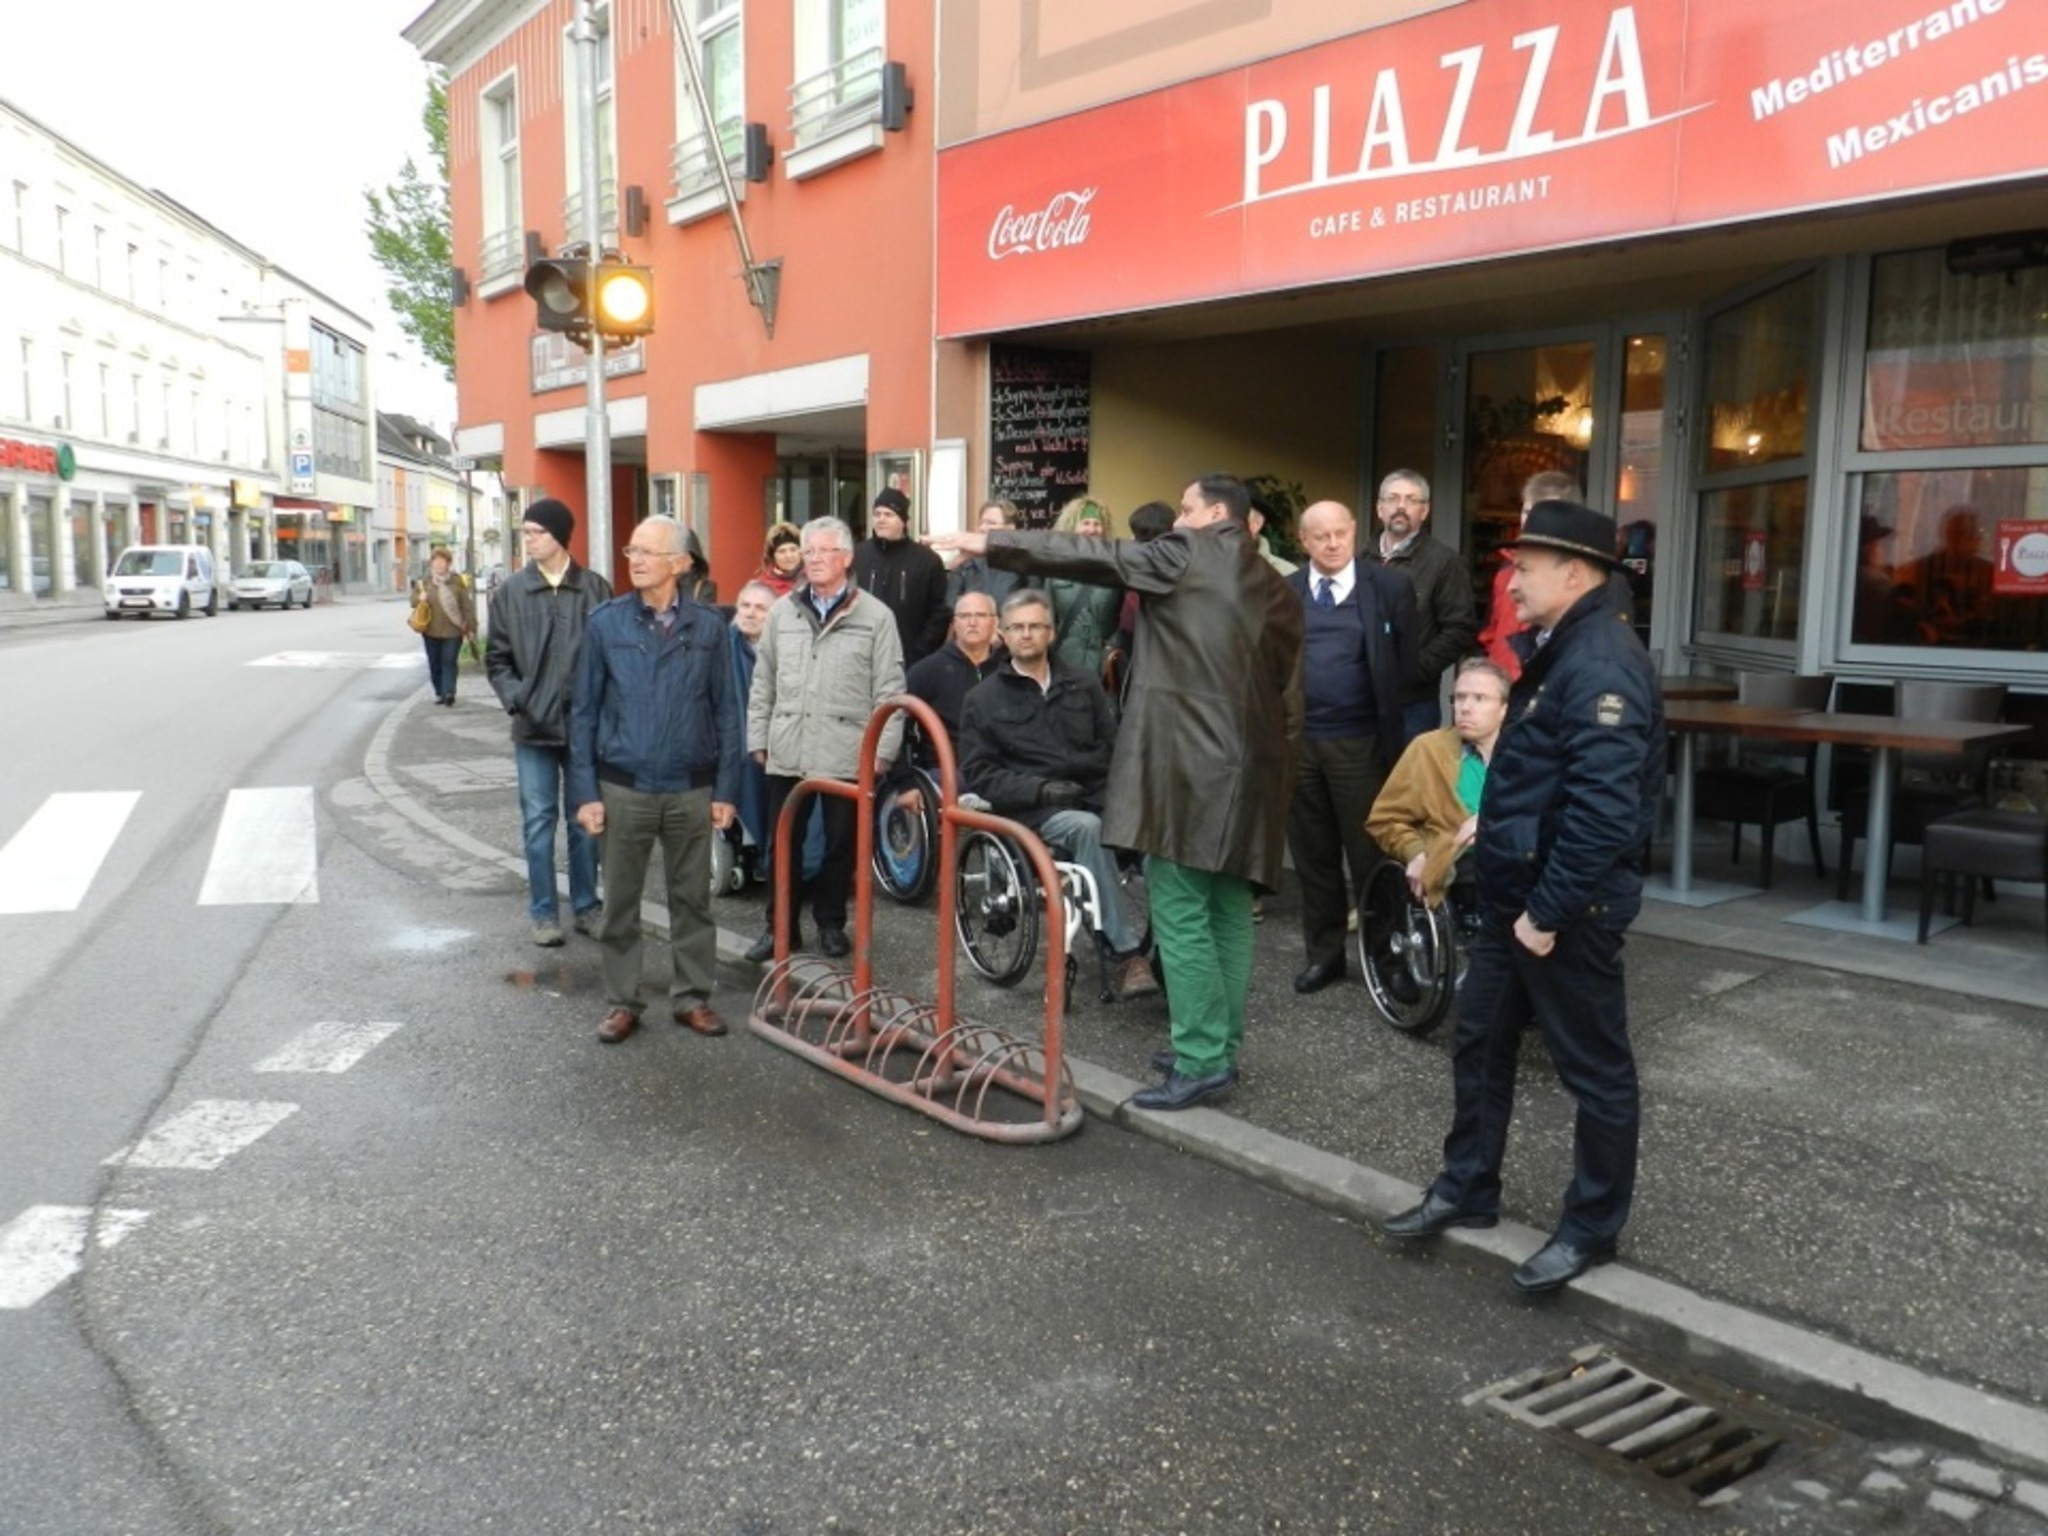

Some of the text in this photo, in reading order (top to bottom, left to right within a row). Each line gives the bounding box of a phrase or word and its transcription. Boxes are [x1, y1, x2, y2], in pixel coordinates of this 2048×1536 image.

[1244, 6, 1651, 202] PIAZZA
[988, 185, 1099, 260] Coca-Cola
[1309, 175, 1552, 238] CAFE & RESTAURANT
[295, 455, 309, 476] P
